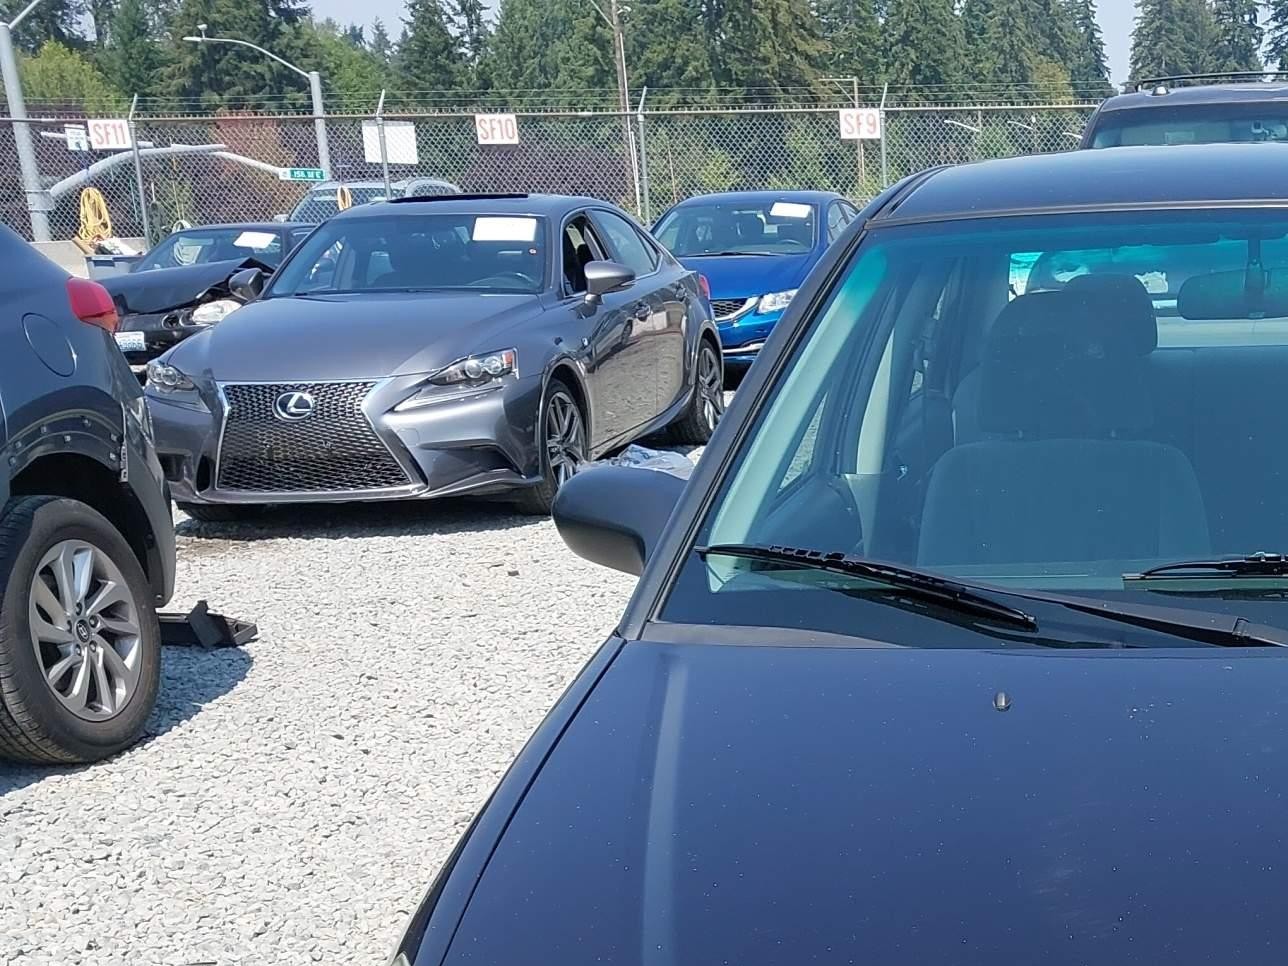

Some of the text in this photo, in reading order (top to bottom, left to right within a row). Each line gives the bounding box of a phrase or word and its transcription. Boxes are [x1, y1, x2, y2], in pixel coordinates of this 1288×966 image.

[92, 122, 127, 146] SF11
[478, 118, 516, 140] SF10
[843, 112, 877, 136] SF9
